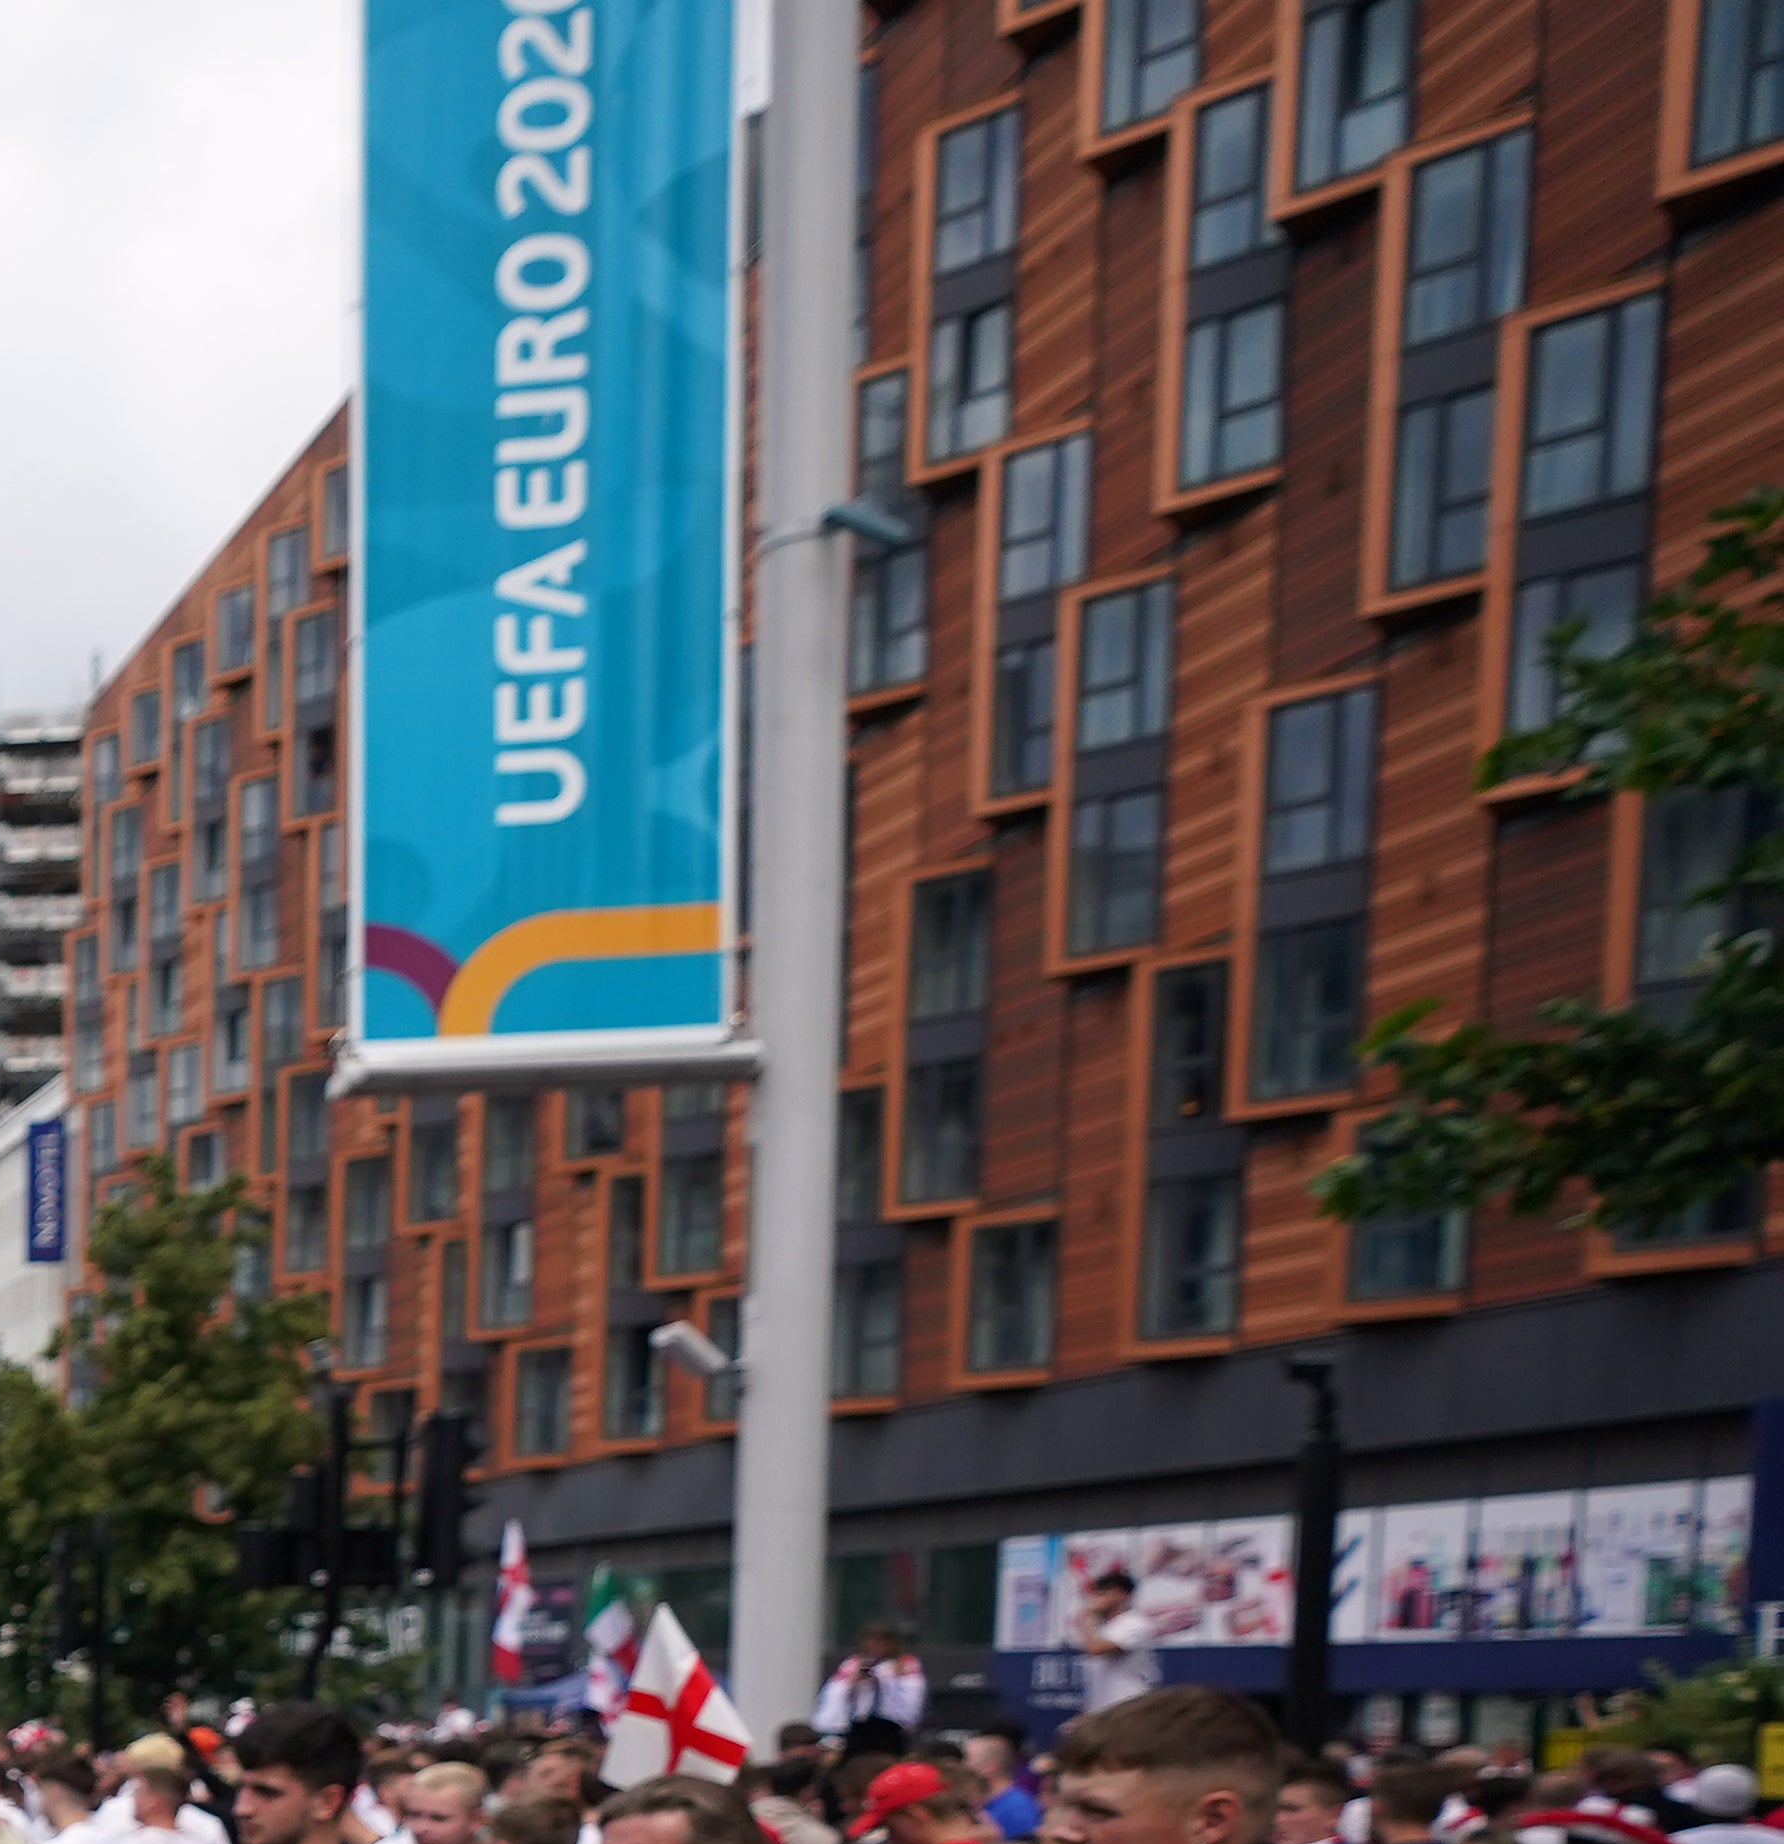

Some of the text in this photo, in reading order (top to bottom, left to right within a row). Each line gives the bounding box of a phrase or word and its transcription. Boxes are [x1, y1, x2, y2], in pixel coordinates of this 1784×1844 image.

[494, 0, 593, 827] UEFA EURO 202
